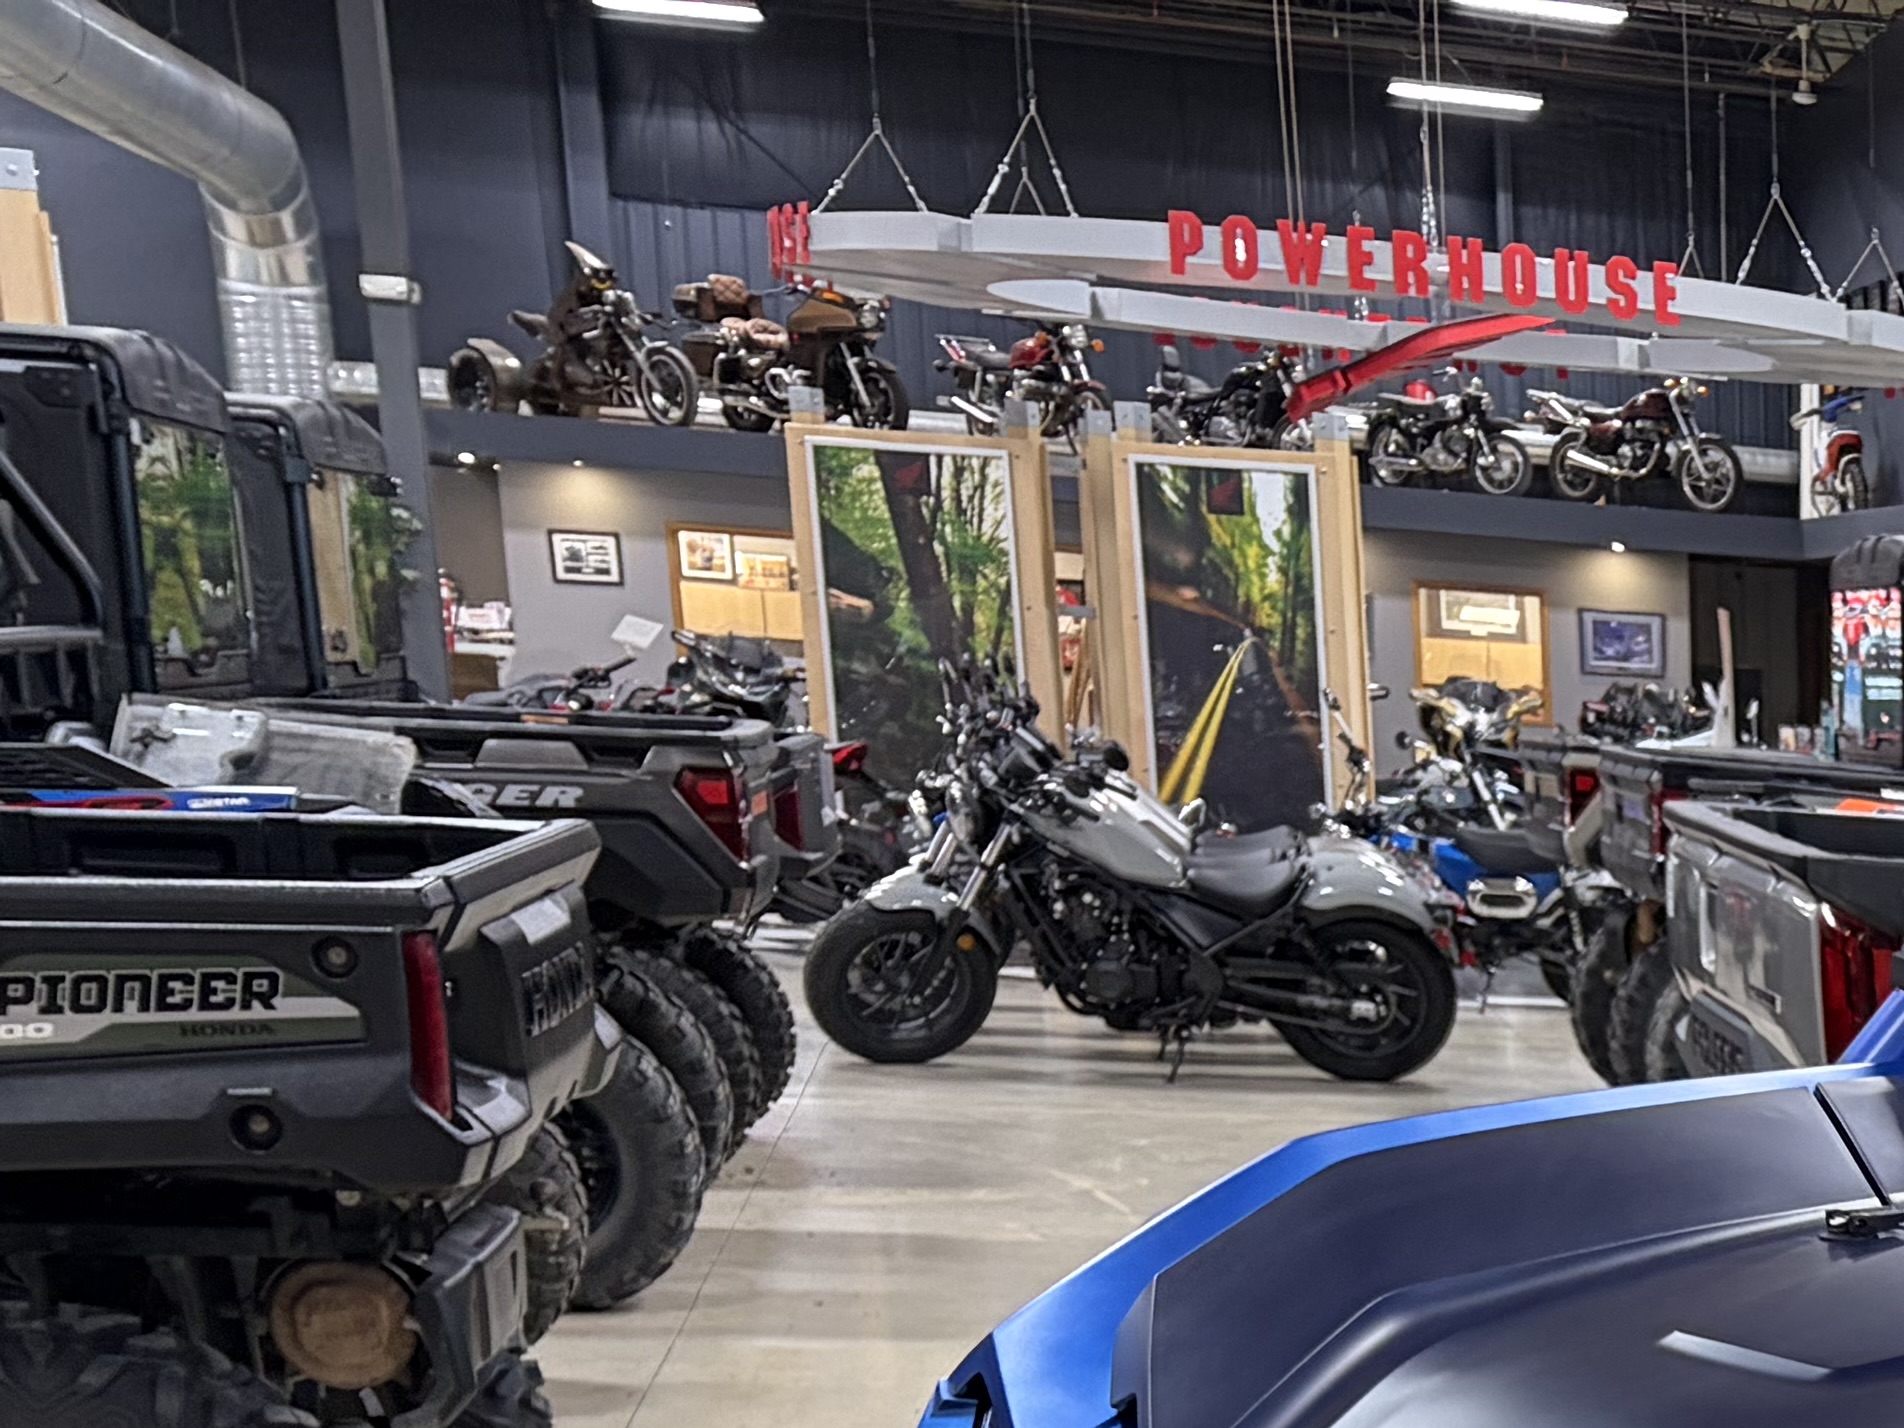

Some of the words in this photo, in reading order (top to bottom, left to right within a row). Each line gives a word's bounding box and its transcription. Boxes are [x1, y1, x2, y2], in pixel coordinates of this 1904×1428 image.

[1168, 209, 1680, 327] POWERHOUSE
[0, 967, 283, 1017] PIONEER
[179, 1023, 276, 1037] HONDA
